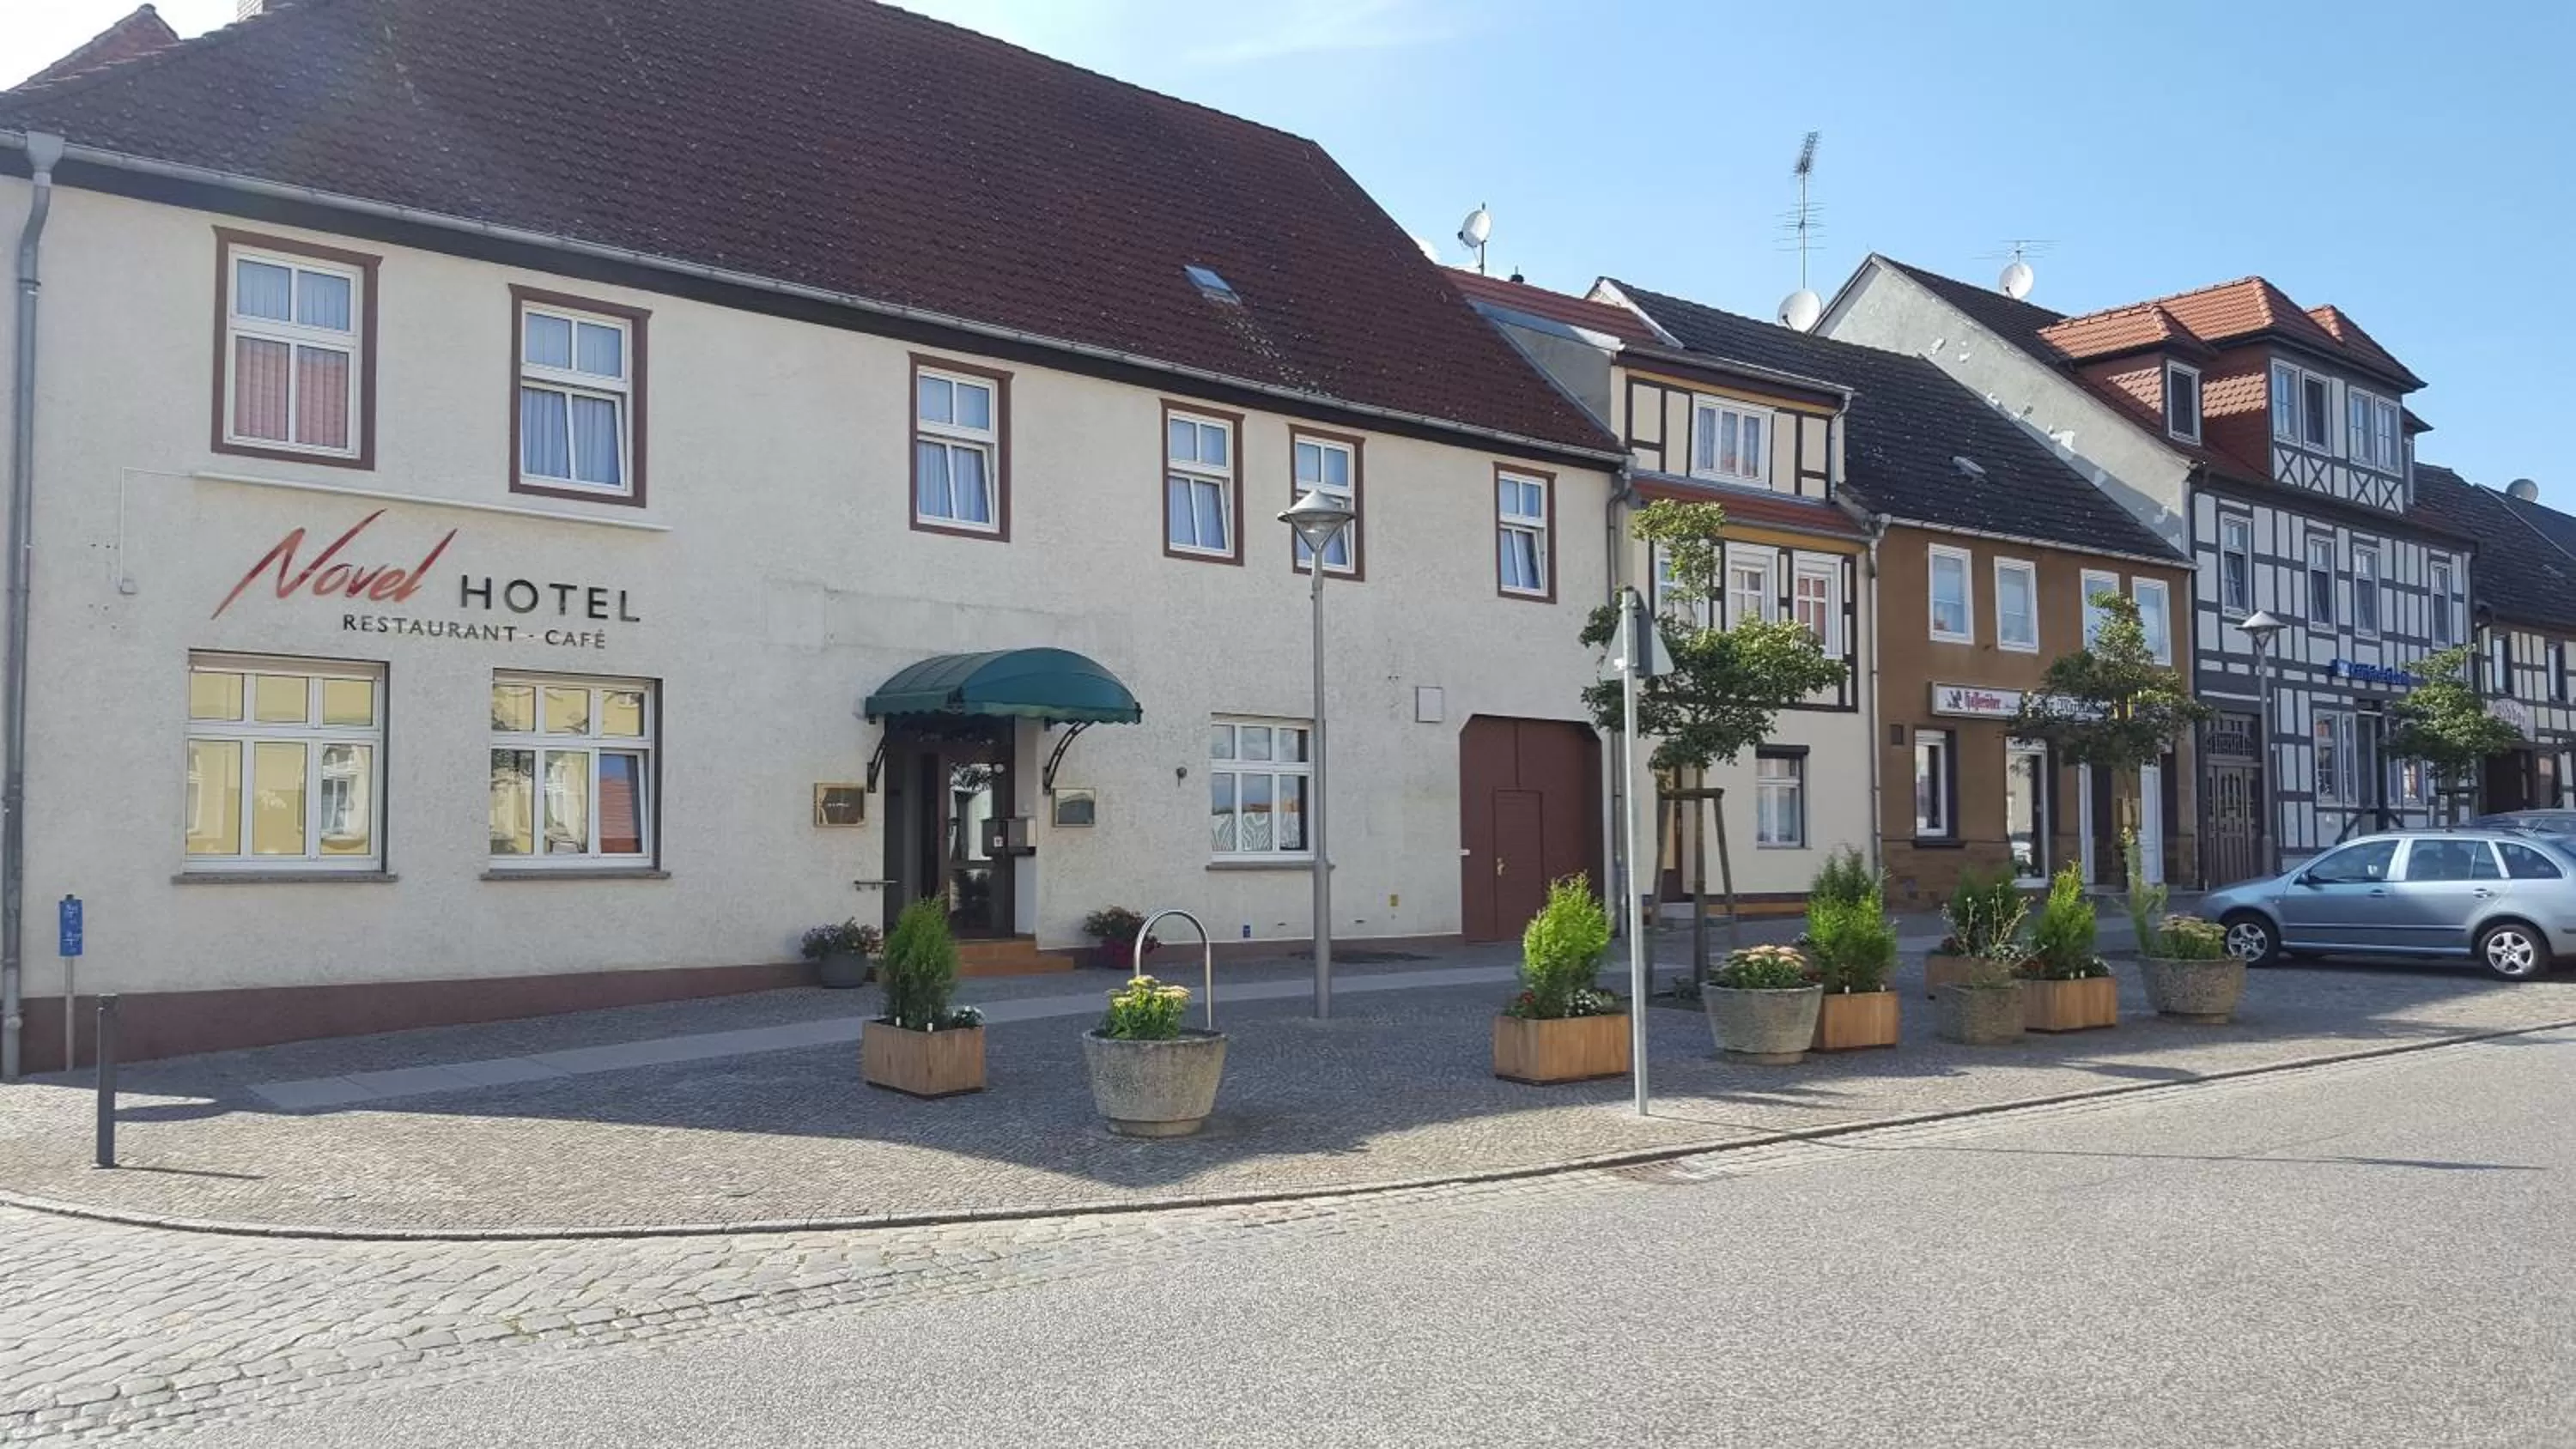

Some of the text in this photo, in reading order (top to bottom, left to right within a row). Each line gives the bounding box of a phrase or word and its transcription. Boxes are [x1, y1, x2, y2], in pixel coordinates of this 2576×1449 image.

[211, 508, 641, 622] Novel HOTEL
[343, 614, 518, 642] RESTAURANT
[545, 627, 605, 650] CAFÉ
